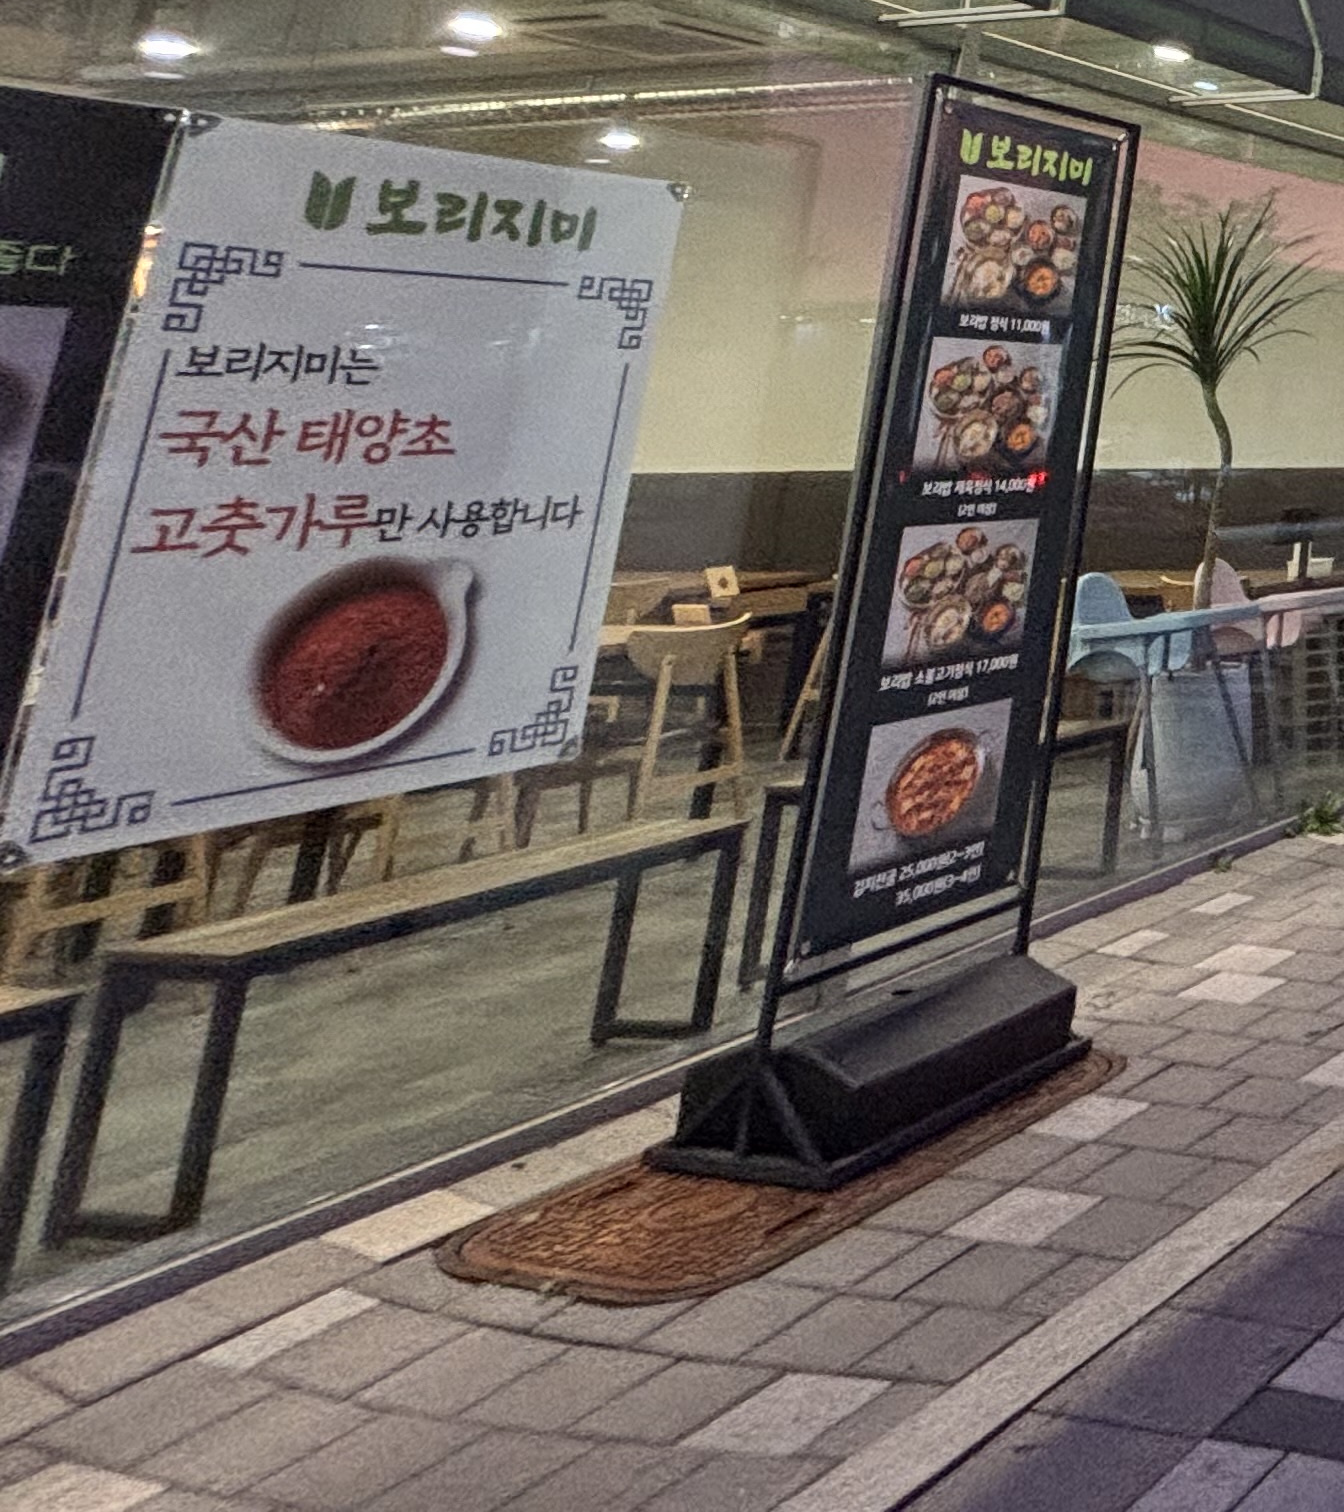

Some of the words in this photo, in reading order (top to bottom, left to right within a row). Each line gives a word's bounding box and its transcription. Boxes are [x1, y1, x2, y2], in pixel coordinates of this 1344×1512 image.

[986, 134, 1094, 186] 보리지미
[365, 178, 598, 251] 보리지미
[959, 313, 989, 331] 보리밥
[990, 315, 1009, 332] 정식
[1011, 318, 1051, 335] 11,000원
[175, 341, 380, 385] 보리지미는
[159, 407, 287, 468] 국산
[296, 408, 457, 466] 태양초
[921, 479, 953, 497] 보리밥
[130, 492, 415, 558] 고춧가루만
[417, 494, 584, 538] 사용합니다
[878, 671, 913, 691] 보리밥
[976, 653, 1019, 674] 17,000원
